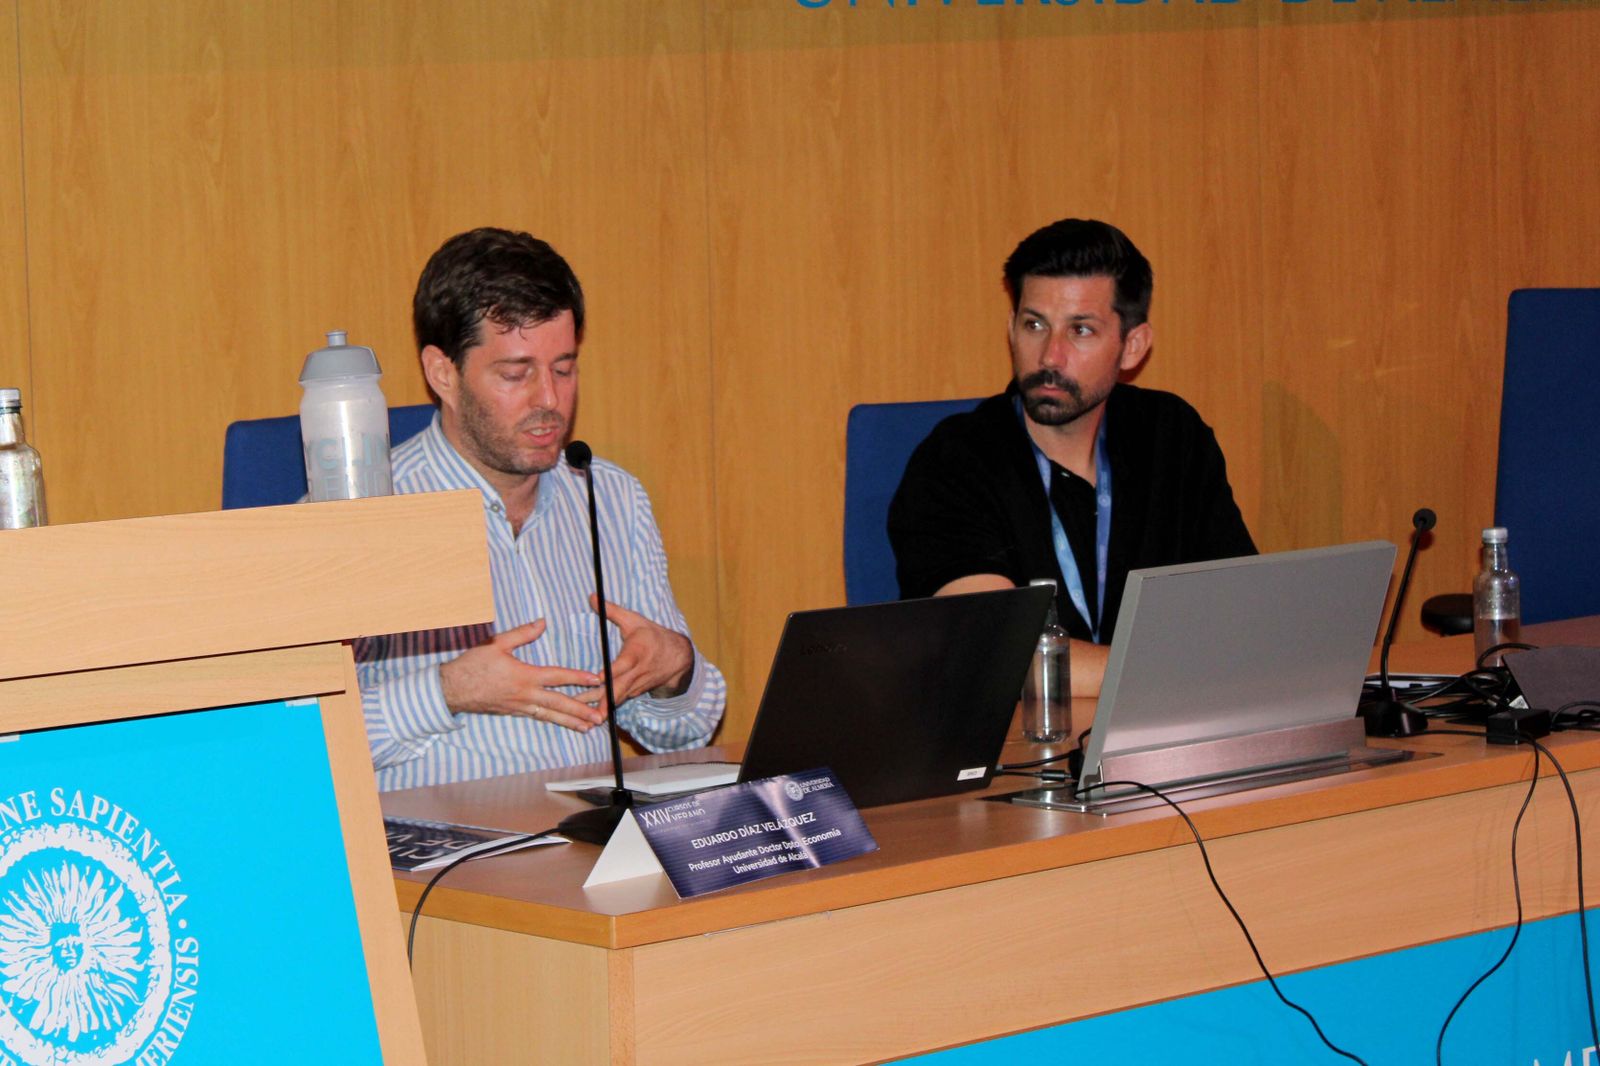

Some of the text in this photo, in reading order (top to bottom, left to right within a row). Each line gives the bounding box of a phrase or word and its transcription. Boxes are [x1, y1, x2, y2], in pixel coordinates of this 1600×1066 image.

[639, 807, 671, 828] XXIV
[691, 811, 817, 849] EDUARDO DÍAZ VELÁZQUEZ
[50, 787, 188, 915] SAPIENTIA
[688, 859, 721, 872] Profesor
[722, 849, 759, 865] Ayudante
[759, 843, 783, 854] Doctor
[802, 827, 842, 846] Economía
[732, 859, 778, 874] Universidad
[135, 936, 199, 1066] ERIENSIS
